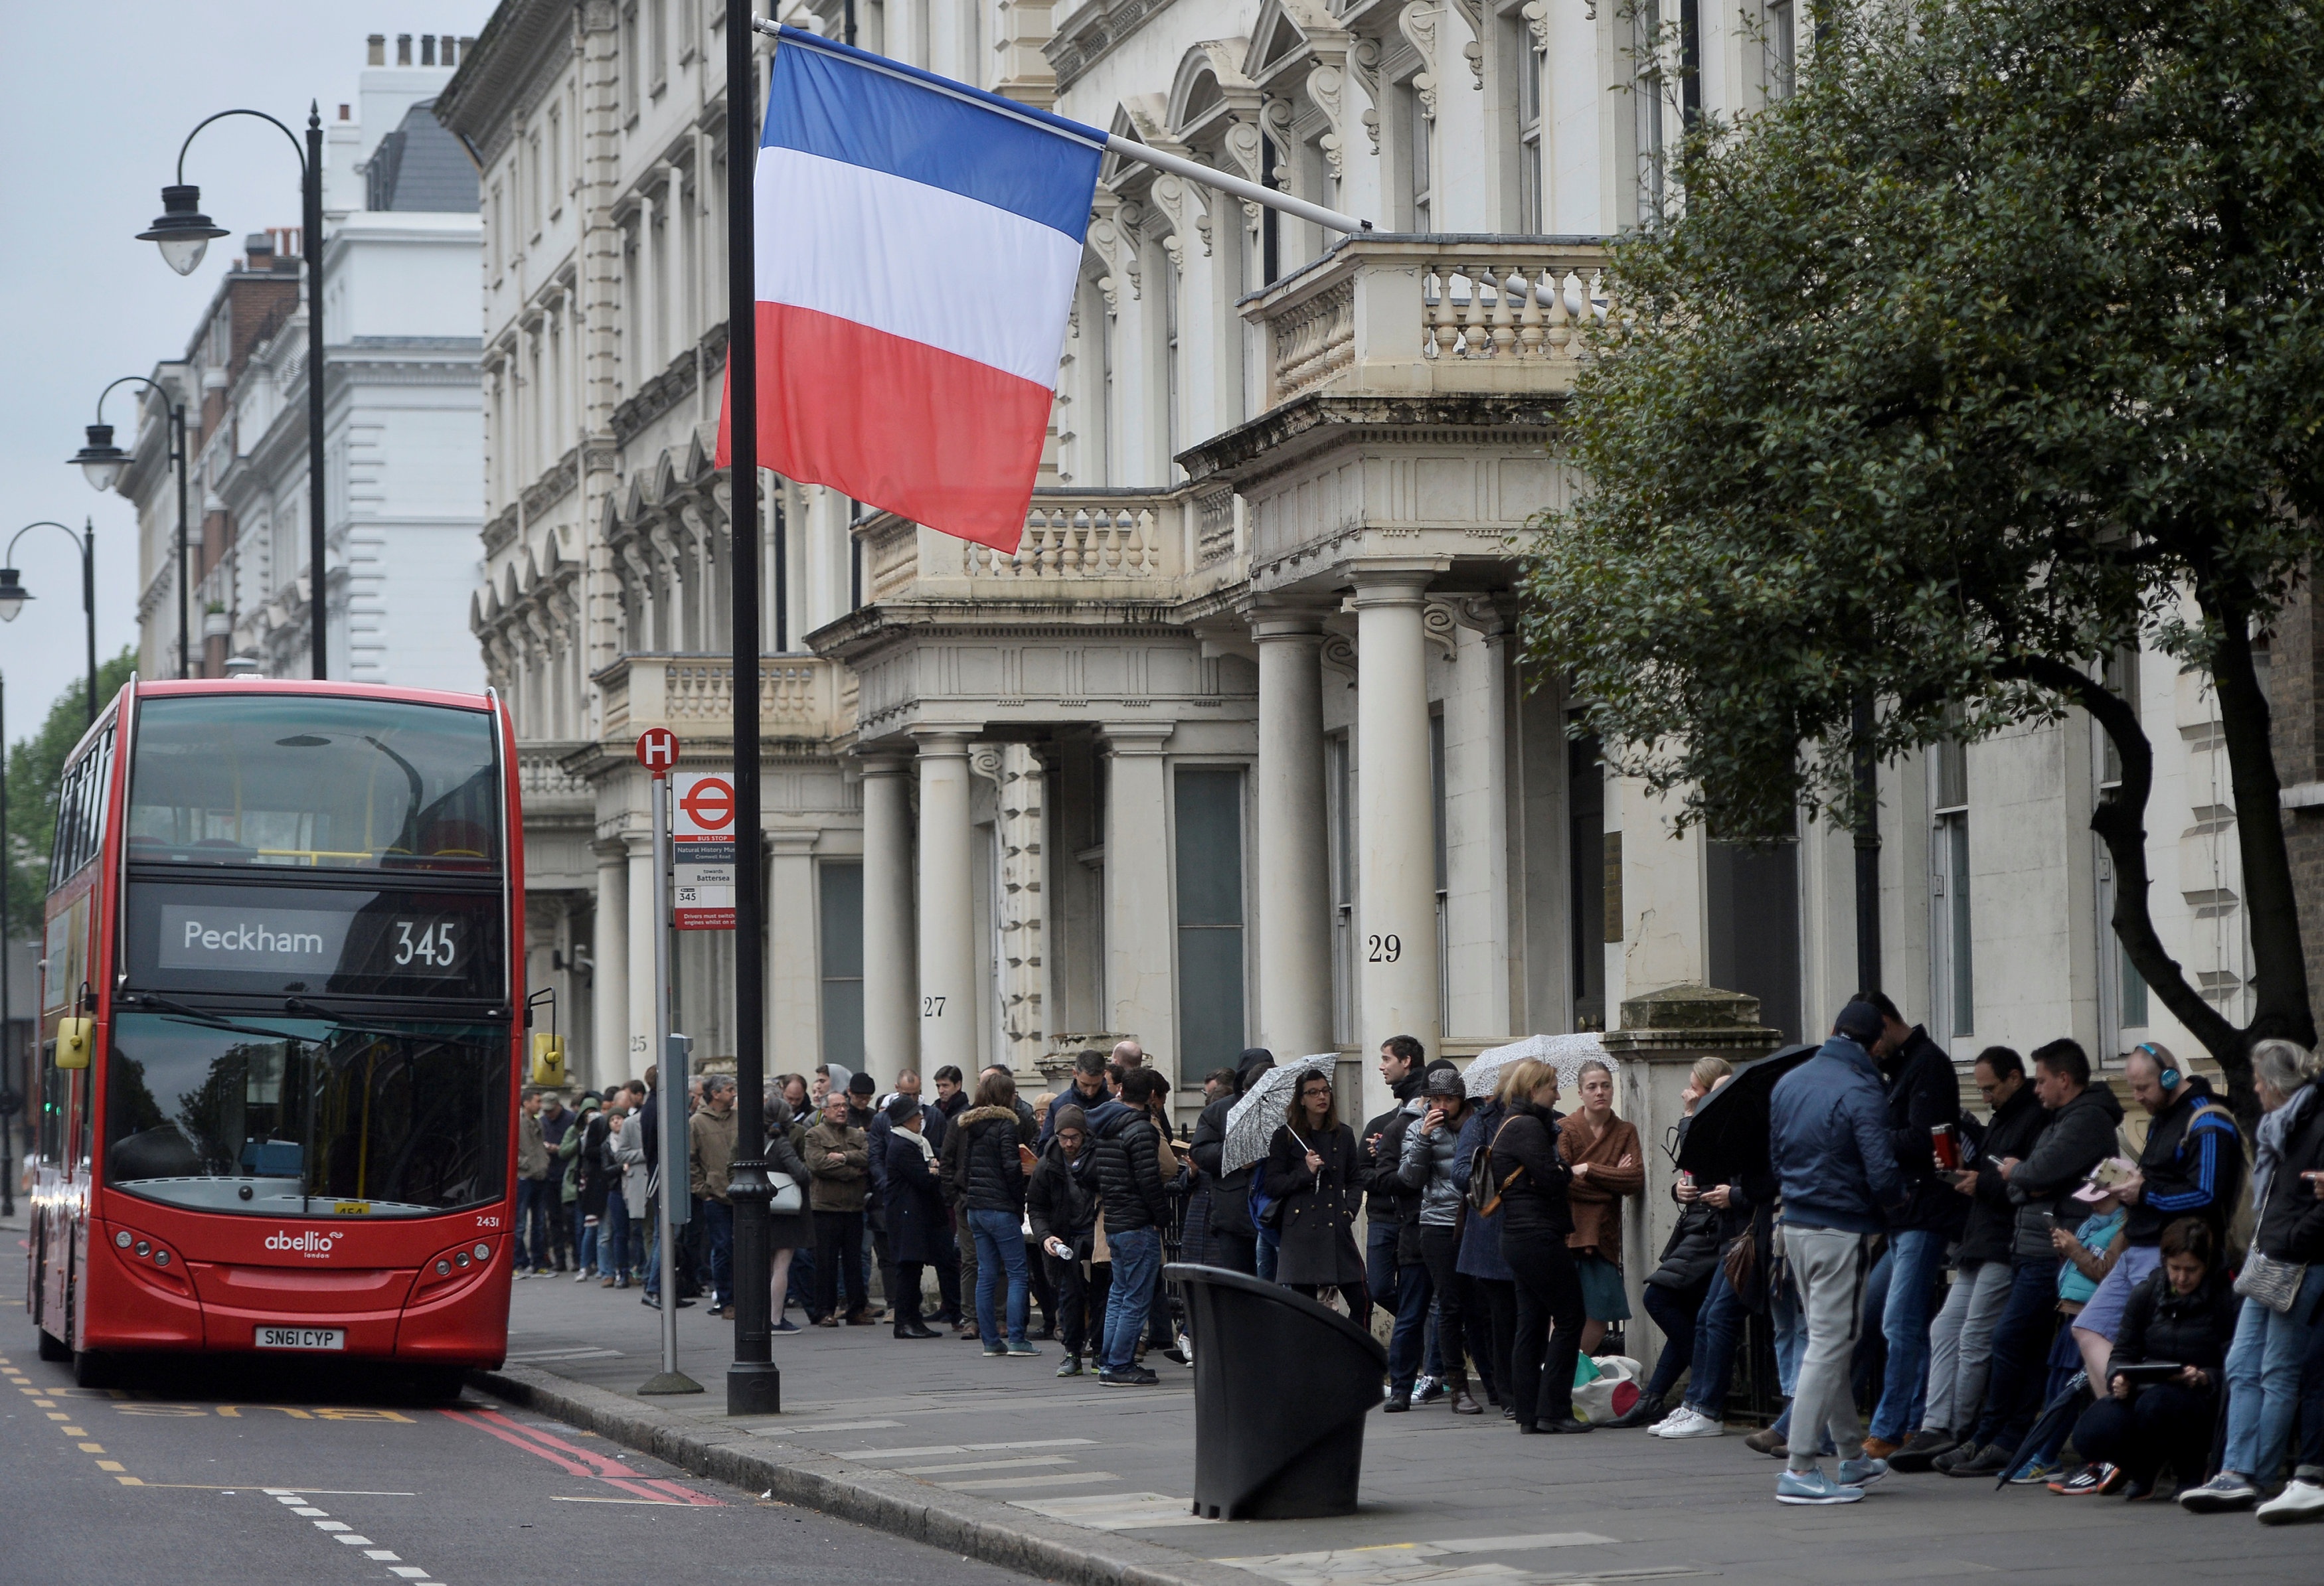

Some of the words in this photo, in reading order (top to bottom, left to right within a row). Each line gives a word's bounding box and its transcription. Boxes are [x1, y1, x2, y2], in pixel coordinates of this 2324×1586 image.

[645, 734, 672, 764] H
[184, 921, 323, 953] Peckham
[394, 921, 456, 967] 345
[1369, 934, 1401, 963] 29
[924, 996, 946, 1017] 27
[631, 1036, 647, 1052] 25
[476, 1216, 499, 1228] 2431
[264, 1229, 333, 1252] abellio
[265, 1330, 299, 1345] SN61
[303, 1331, 333, 1346] CYP
[110, 1403, 418, 1424] BUS
